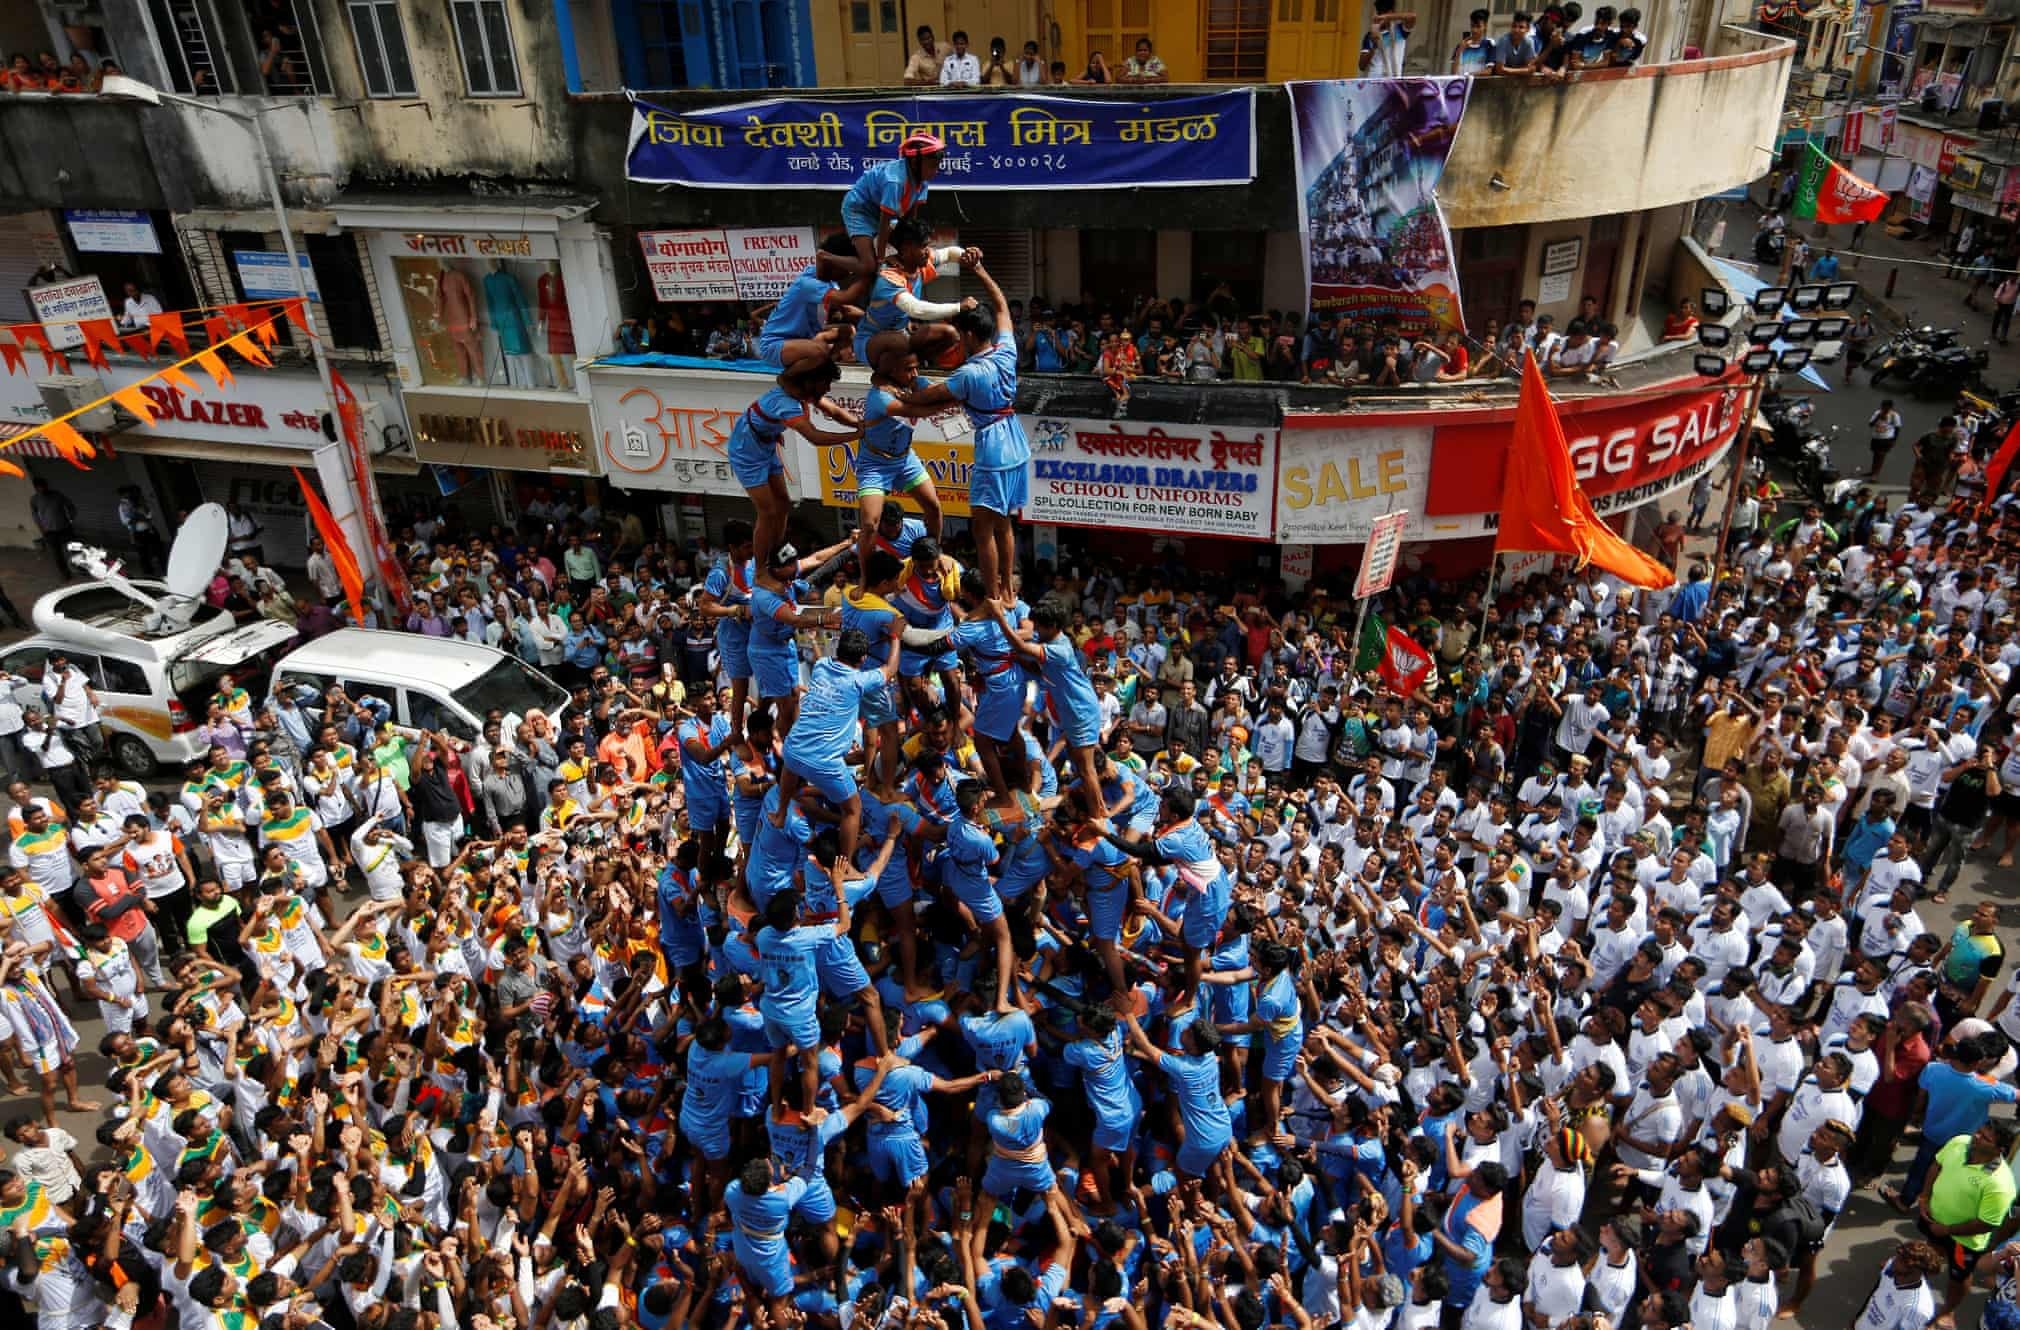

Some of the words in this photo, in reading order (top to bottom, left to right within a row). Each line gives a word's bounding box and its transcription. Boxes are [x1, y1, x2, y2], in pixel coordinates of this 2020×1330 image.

[647, 111, 724, 147] जिवा
[740, 111, 844, 149] देवशी
[1008, 106, 1094, 146] मित्र
[1114, 106, 1221, 144] मंडळ
[989, 154, 1067, 171] ४०००२८
[402, 232, 466, 255] जनता
[658, 237, 727, 257] योगायोग
[743, 234, 799, 251] FRENCH
[734, 257, 774, 274] ENGLISH
[139, 385, 269, 430] BLAZER
[1075, 422, 1201, 463] एक्सेलसियर
[1209, 430, 1265, 471] ड्रेपर्स
[1569, 427, 1637, 480] GG
[1035, 459, 1151, 486] EXCELSIOR
[1154, 466, 1258, 493] DRAPERS
[1284, 448, 1408, 510] SALE
[1049, 480, 1130, 499] SCHOOL
[1135, 486, 1243, 507] UNIFORMS
[1614, 476, 1671, 507] FACTORY
[1034, 496, 1130, 513] SPL.COLLECTION
[1133, 503, 1156, 515] FOR
[1159, 504, 1186, 517] NEW
[1188, 507, 1224, 520] BORN
[1225, 509, 1259, 522] BABY
